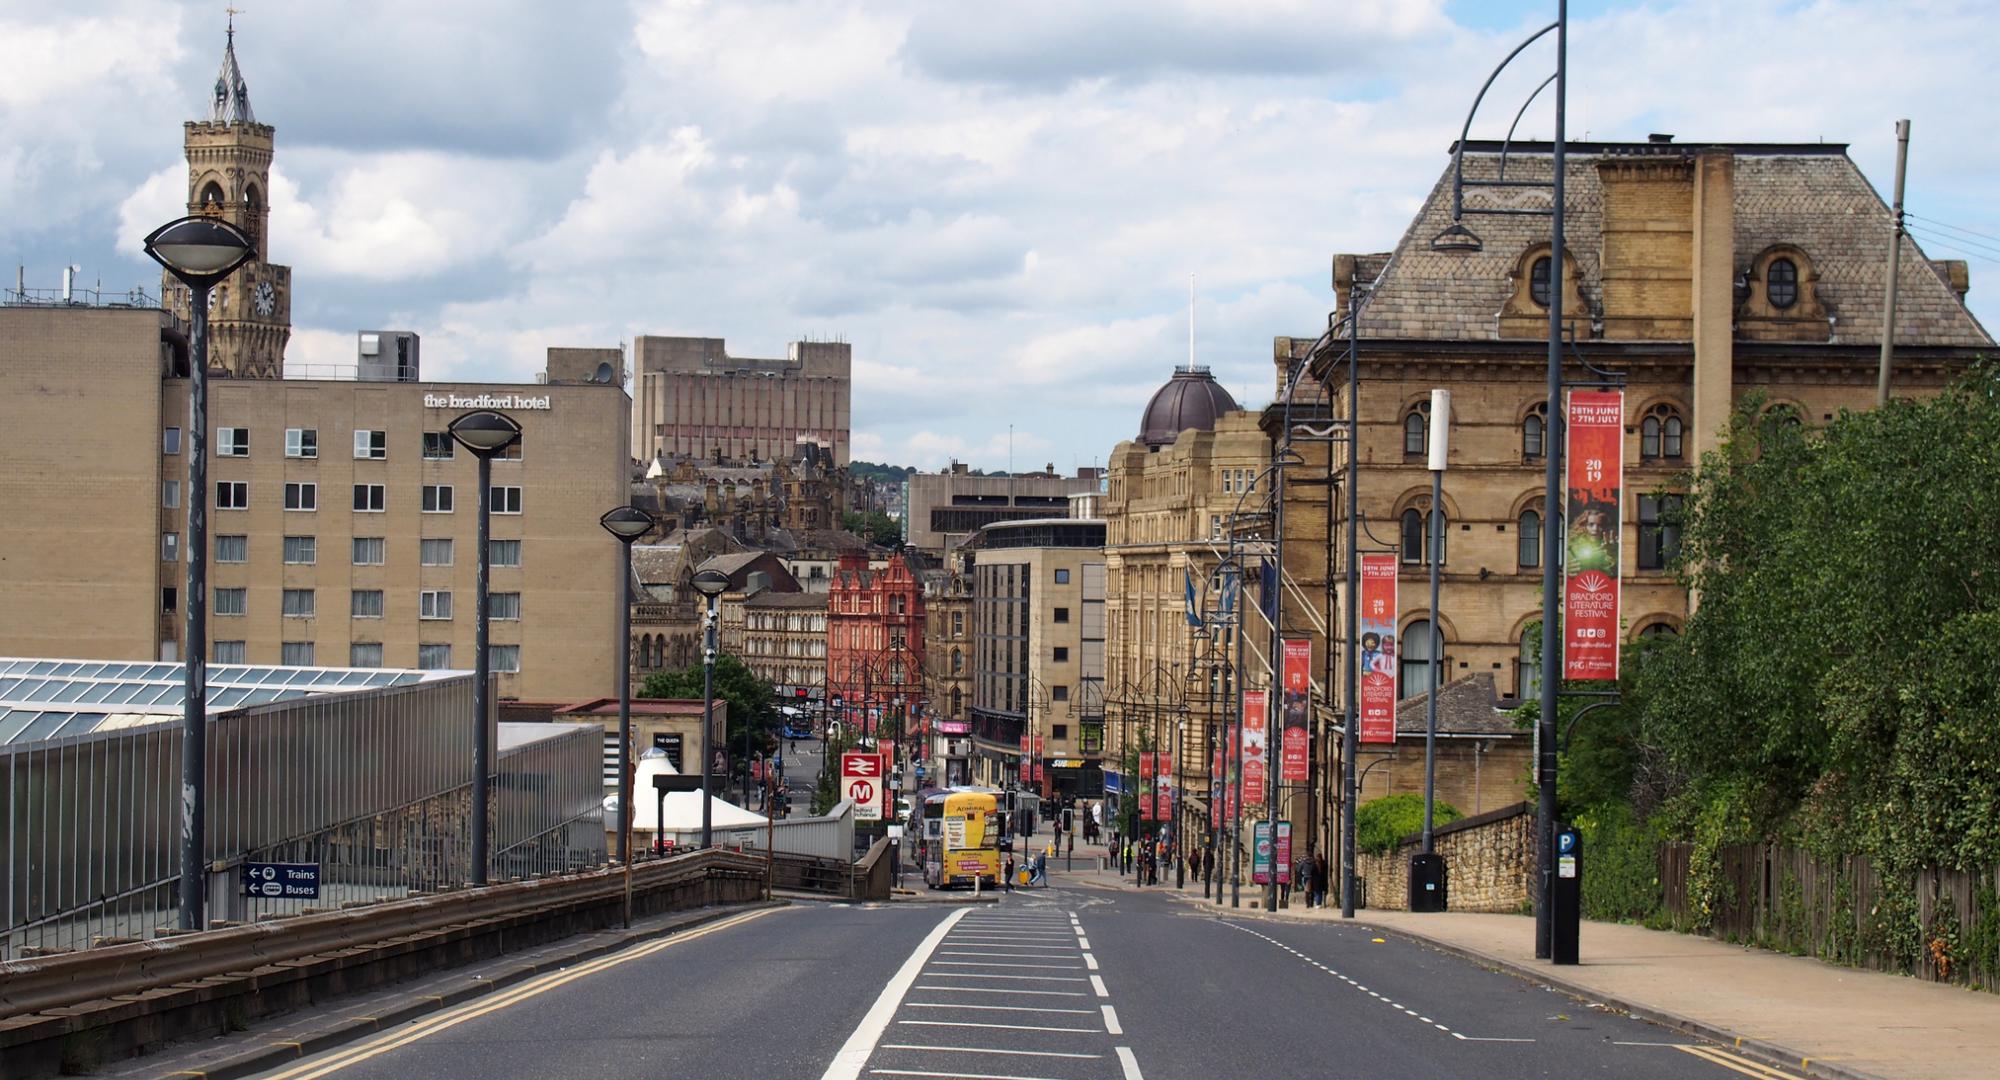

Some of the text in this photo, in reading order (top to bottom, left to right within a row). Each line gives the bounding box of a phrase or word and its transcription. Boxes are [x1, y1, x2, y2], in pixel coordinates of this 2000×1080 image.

[424, 394, 550, 409] the bradford hotel
[1571, 407, 1619, 415] 28TH JUNE
[1586, 459, 1602, 470] 20
[1587, 471, 1602, 482] 19
[1570, 593, 1613, 601] BRADFORD
[1570, 601, 1614, 609] LITERATURE
[1052, 759, 1086, 768] SUBWAY
[850, 784, 871, 800] M
[1561, 835, 1571, 849] P
[286, 869, 315, 879] Trains
[286, 885, 315, 895] Buses
